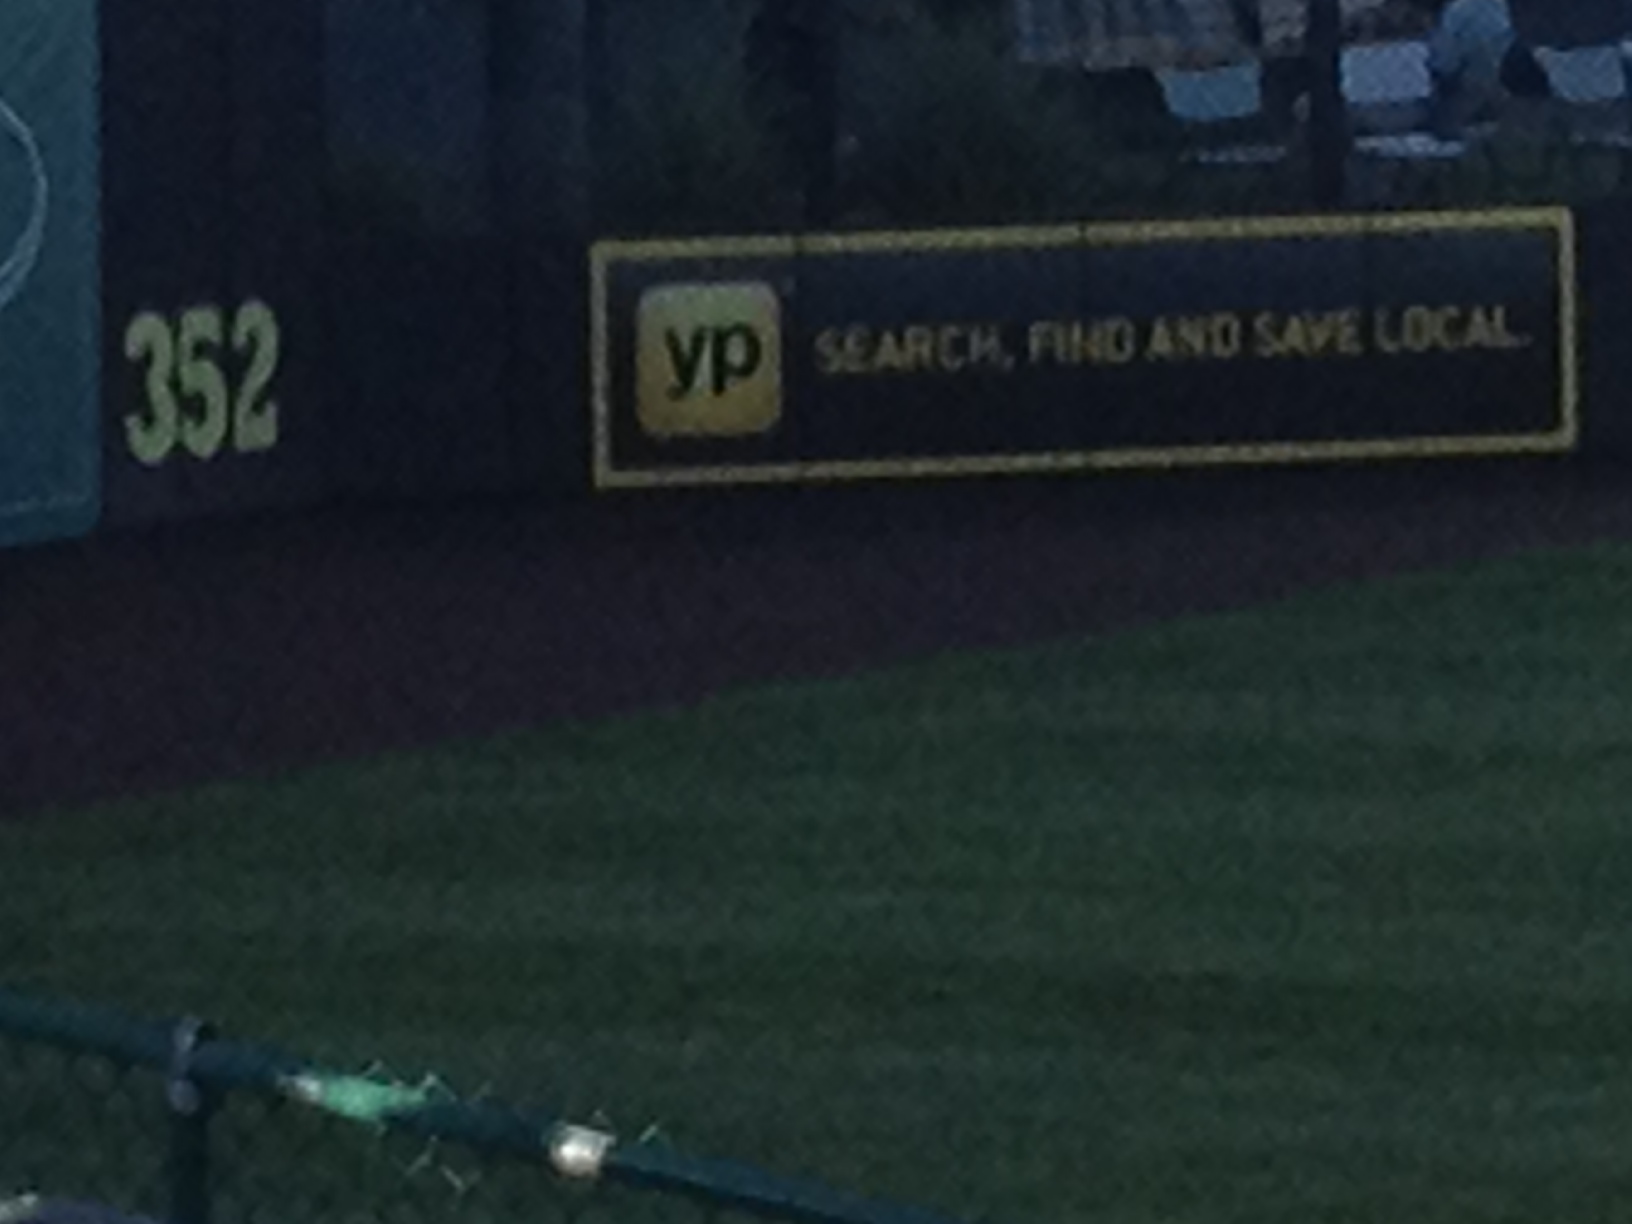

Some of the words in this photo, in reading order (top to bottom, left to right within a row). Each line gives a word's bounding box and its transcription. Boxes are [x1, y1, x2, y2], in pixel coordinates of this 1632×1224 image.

[662, 319, 762, 402] yp
[813, 323, 1015, 376] SEARCH,
[1028, 316, 1135, 366] FIND
[1146, 313, 1240, 361] AND
[1255, 309, 1362, 358] SAVE
[1375, 303, 1532, 351] LOCAL.
[124, 298, 280, 466] 352
